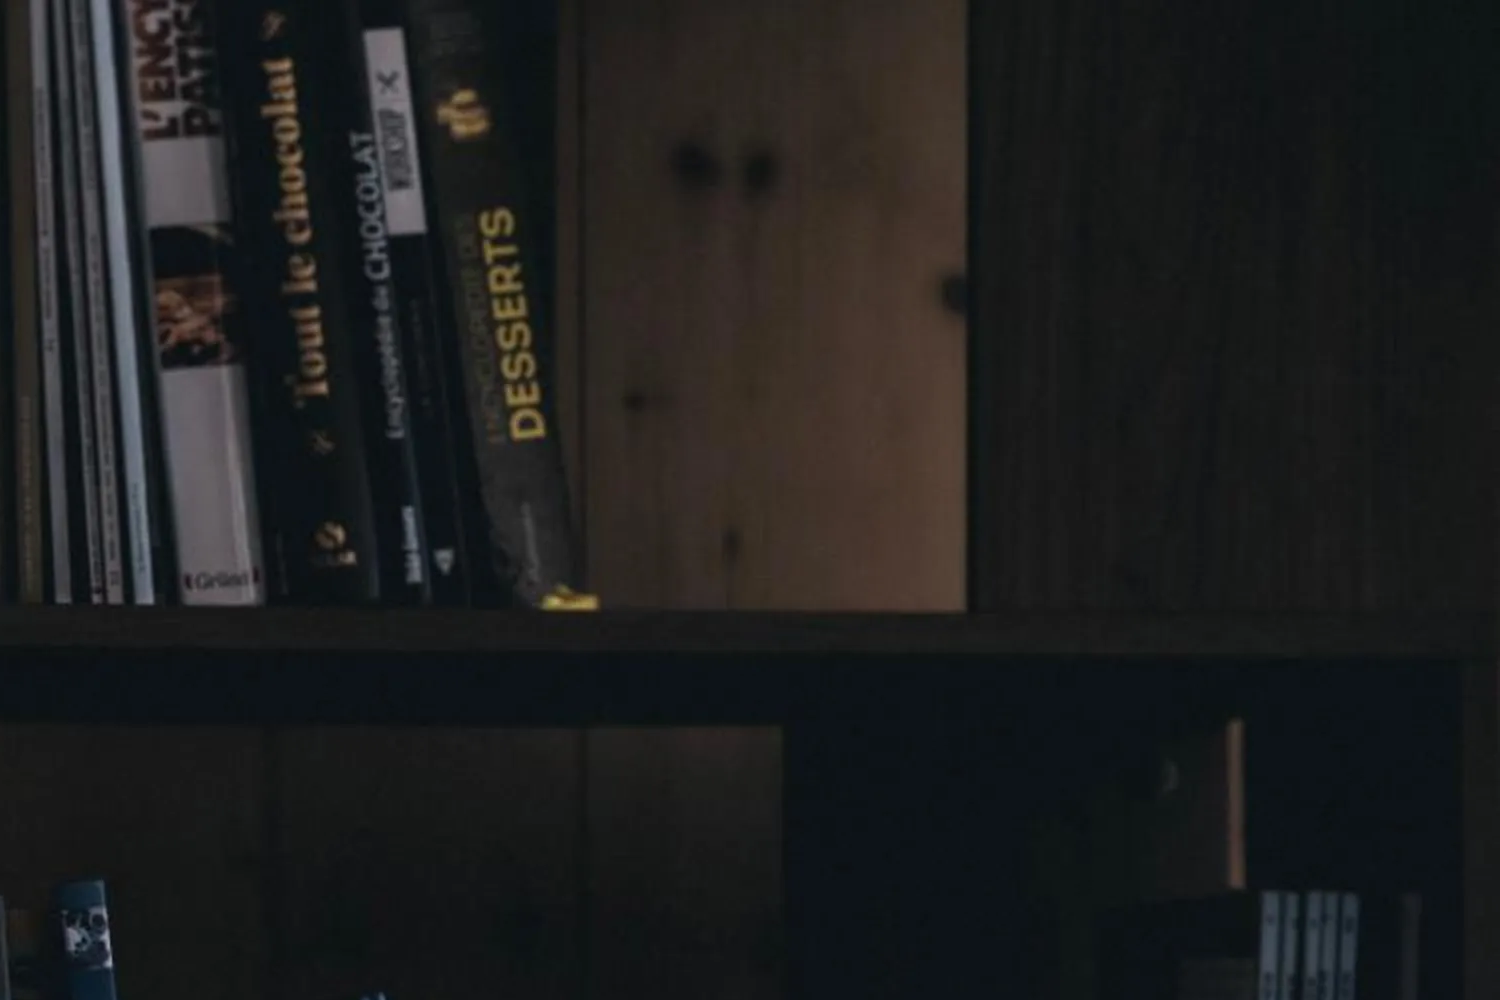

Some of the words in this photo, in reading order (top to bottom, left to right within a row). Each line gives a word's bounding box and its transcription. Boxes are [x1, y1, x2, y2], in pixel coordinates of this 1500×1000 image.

[172, 0, 219, 137] PATIS
[259, 55, 314, 245] chocolat
[349, 128, 393, 282] CHOCOLAT
[281, 252, 319, 295] le
[478, 205, 548, 442] DESSERTS
[283, 303, 331, 408] Tout
